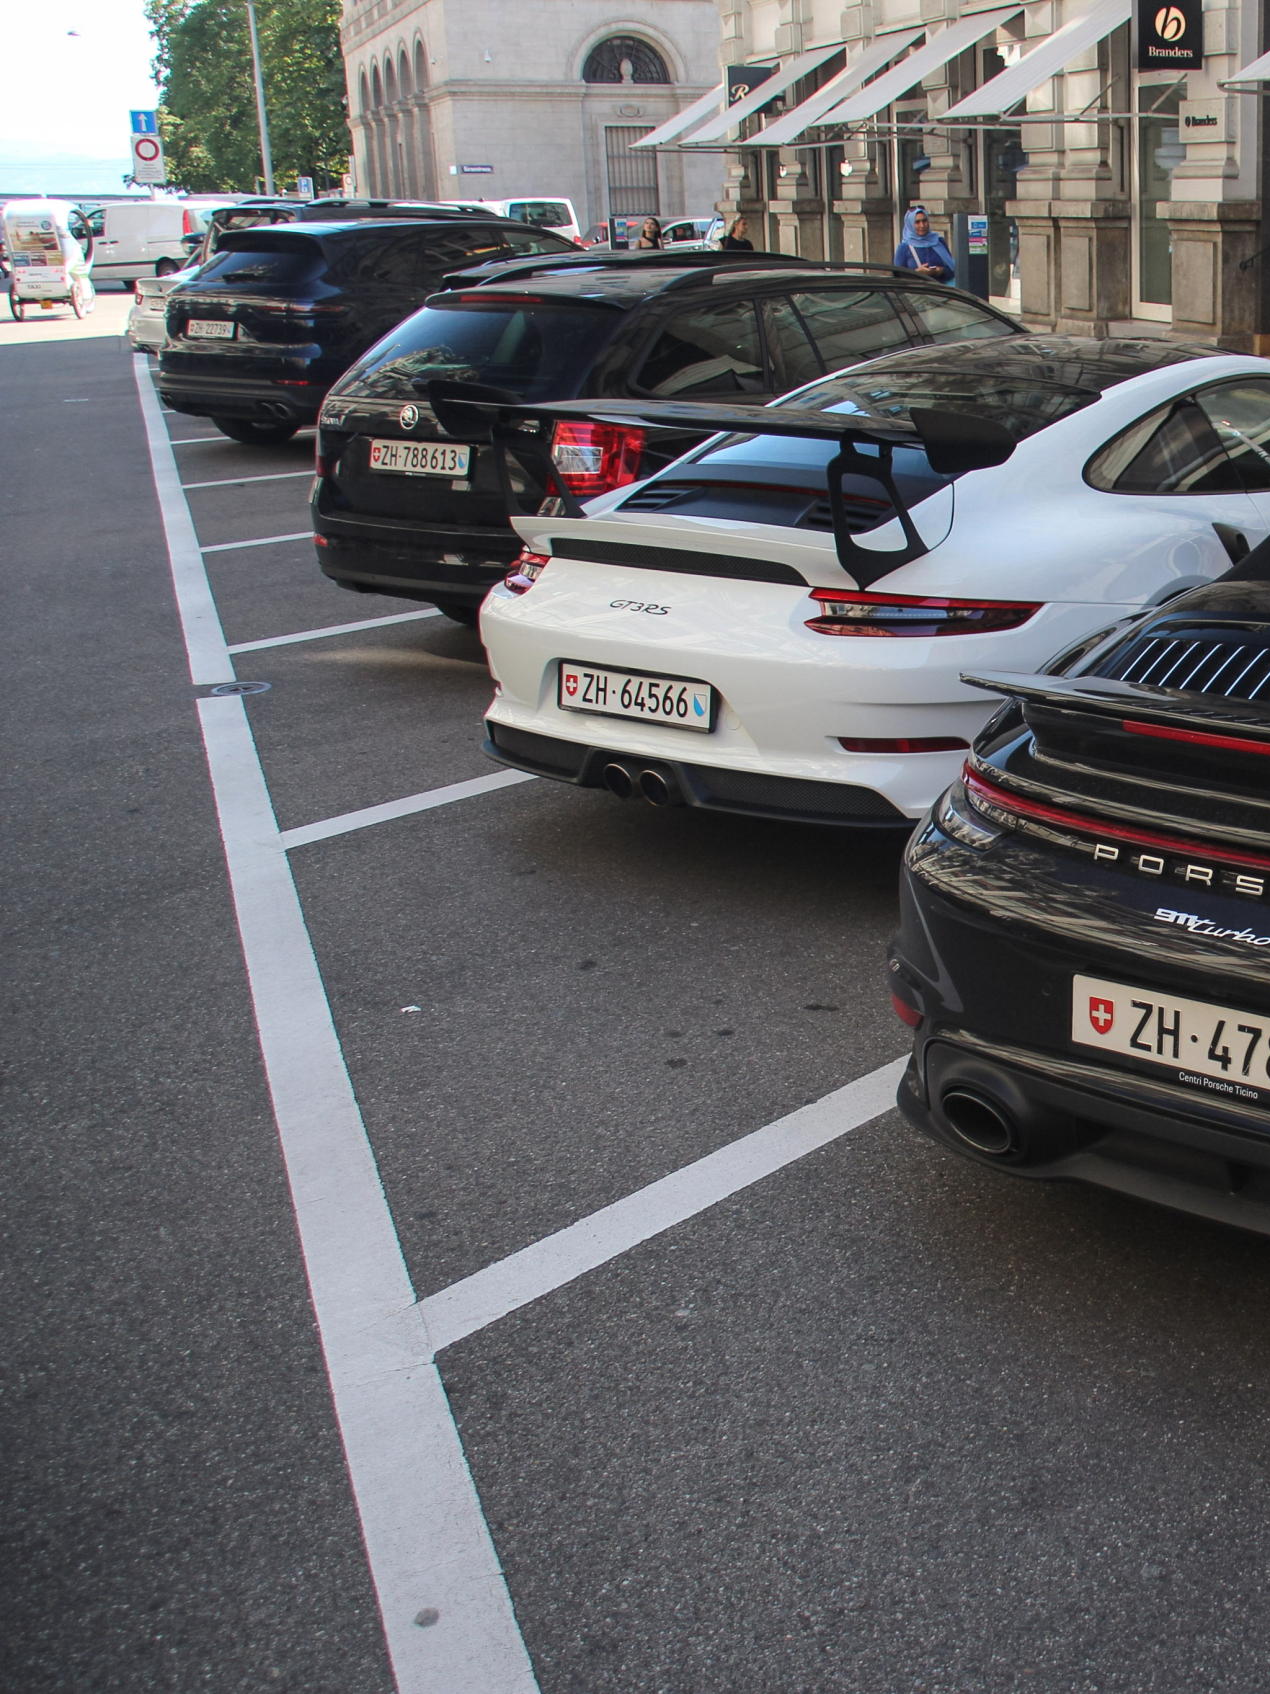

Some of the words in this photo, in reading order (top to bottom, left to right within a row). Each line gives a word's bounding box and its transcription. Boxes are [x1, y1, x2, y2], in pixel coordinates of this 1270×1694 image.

[1148, 46, 1194, 58] Branders
[1179, 1071, 1202, 1085] Centri
[1203, 1077, 1234, 1093] Porsche
[1235, 1085, 1259, 1099] Ticino
